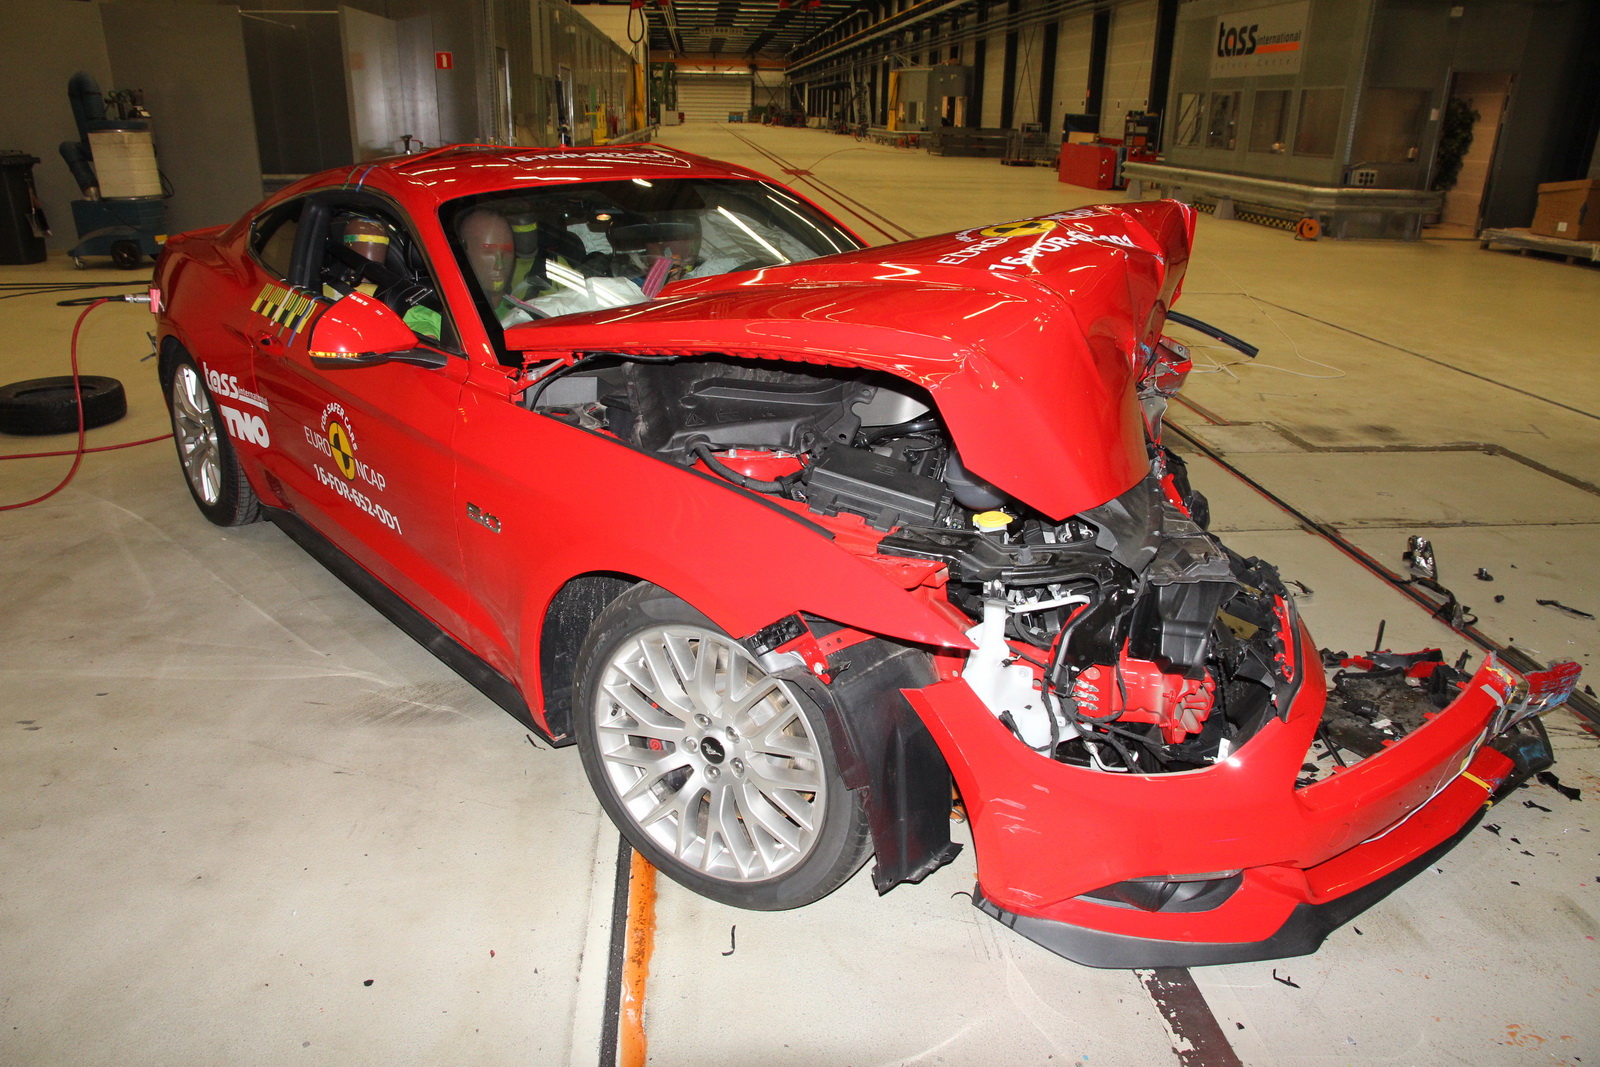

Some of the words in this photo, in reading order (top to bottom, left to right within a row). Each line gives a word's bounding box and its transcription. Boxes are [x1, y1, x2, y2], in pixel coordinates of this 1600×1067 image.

[1217, 22, 1259, 57] tass
[1257, 30, 1301, 44] international
[203, 361, 239, 400] tass
[237, 386, 269, 406] international
[220, 404, 270, 449] TNO
[304, 425, 332, 458] EURO
[326, 402, 345, 419] SAFER
[344, 416, 358, 451] CARS
[354, 458, 386, 492] NCAP
